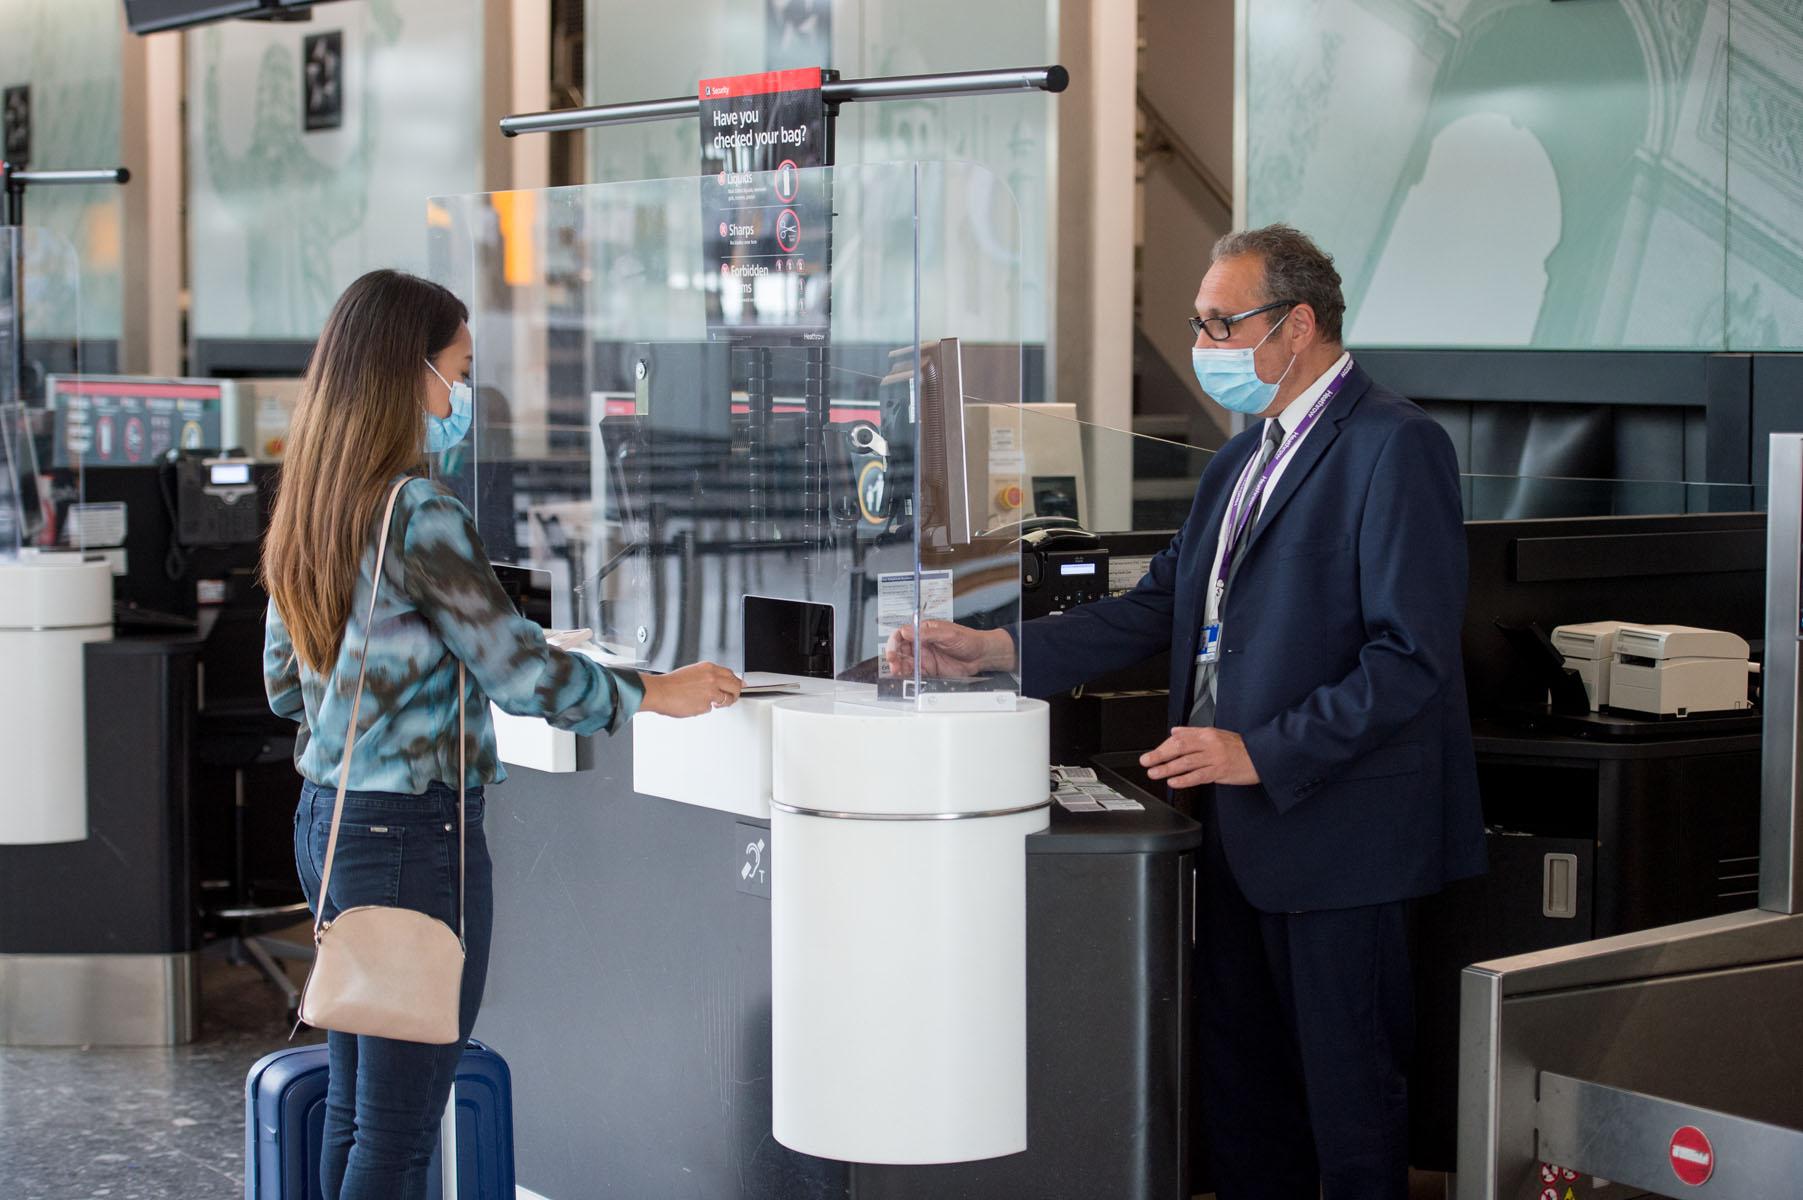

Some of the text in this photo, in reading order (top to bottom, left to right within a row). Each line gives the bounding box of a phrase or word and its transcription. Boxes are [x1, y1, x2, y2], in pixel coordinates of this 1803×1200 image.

[712, 86, 730, 95] Security
[713, 110, 759, 128] Have you
[713, 125, 807, 149] checked your bag?
[727, 171, 753, 187] Liquids
[729, 223, 755, 238] Sharps
[731, 263, 769, 277] Forbidden
[1308, 389, 1333, 418] Heathrow
[1275, 431, 1299, 460] Heathrow
[758, 869, 765, 884] T
